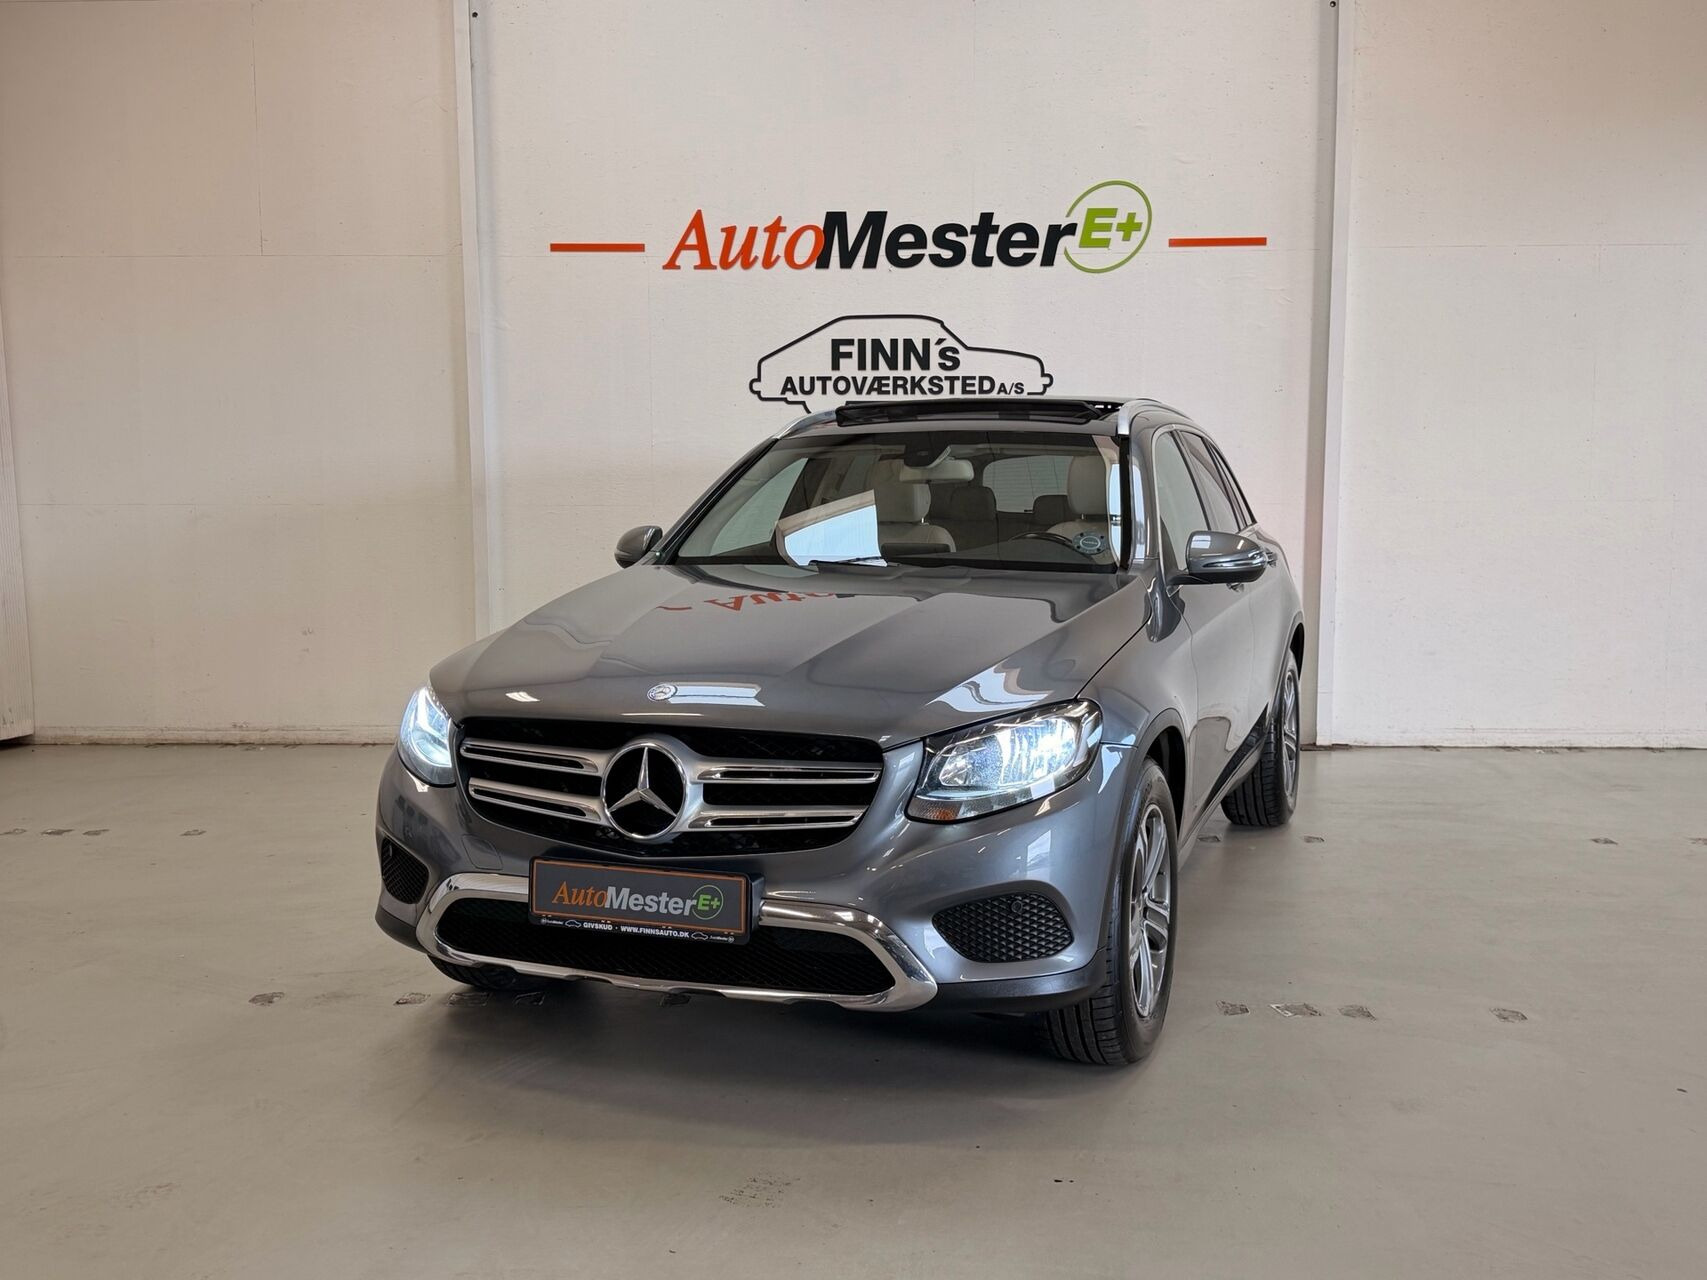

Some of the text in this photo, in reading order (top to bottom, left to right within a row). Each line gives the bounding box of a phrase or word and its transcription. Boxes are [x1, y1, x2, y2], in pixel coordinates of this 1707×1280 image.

[780, 375, 1025, 396] AUTOVÆRKSTED A/S
[583, 922, 690, 938] GIVSKUD WWW.FINNSAUTO.DK
